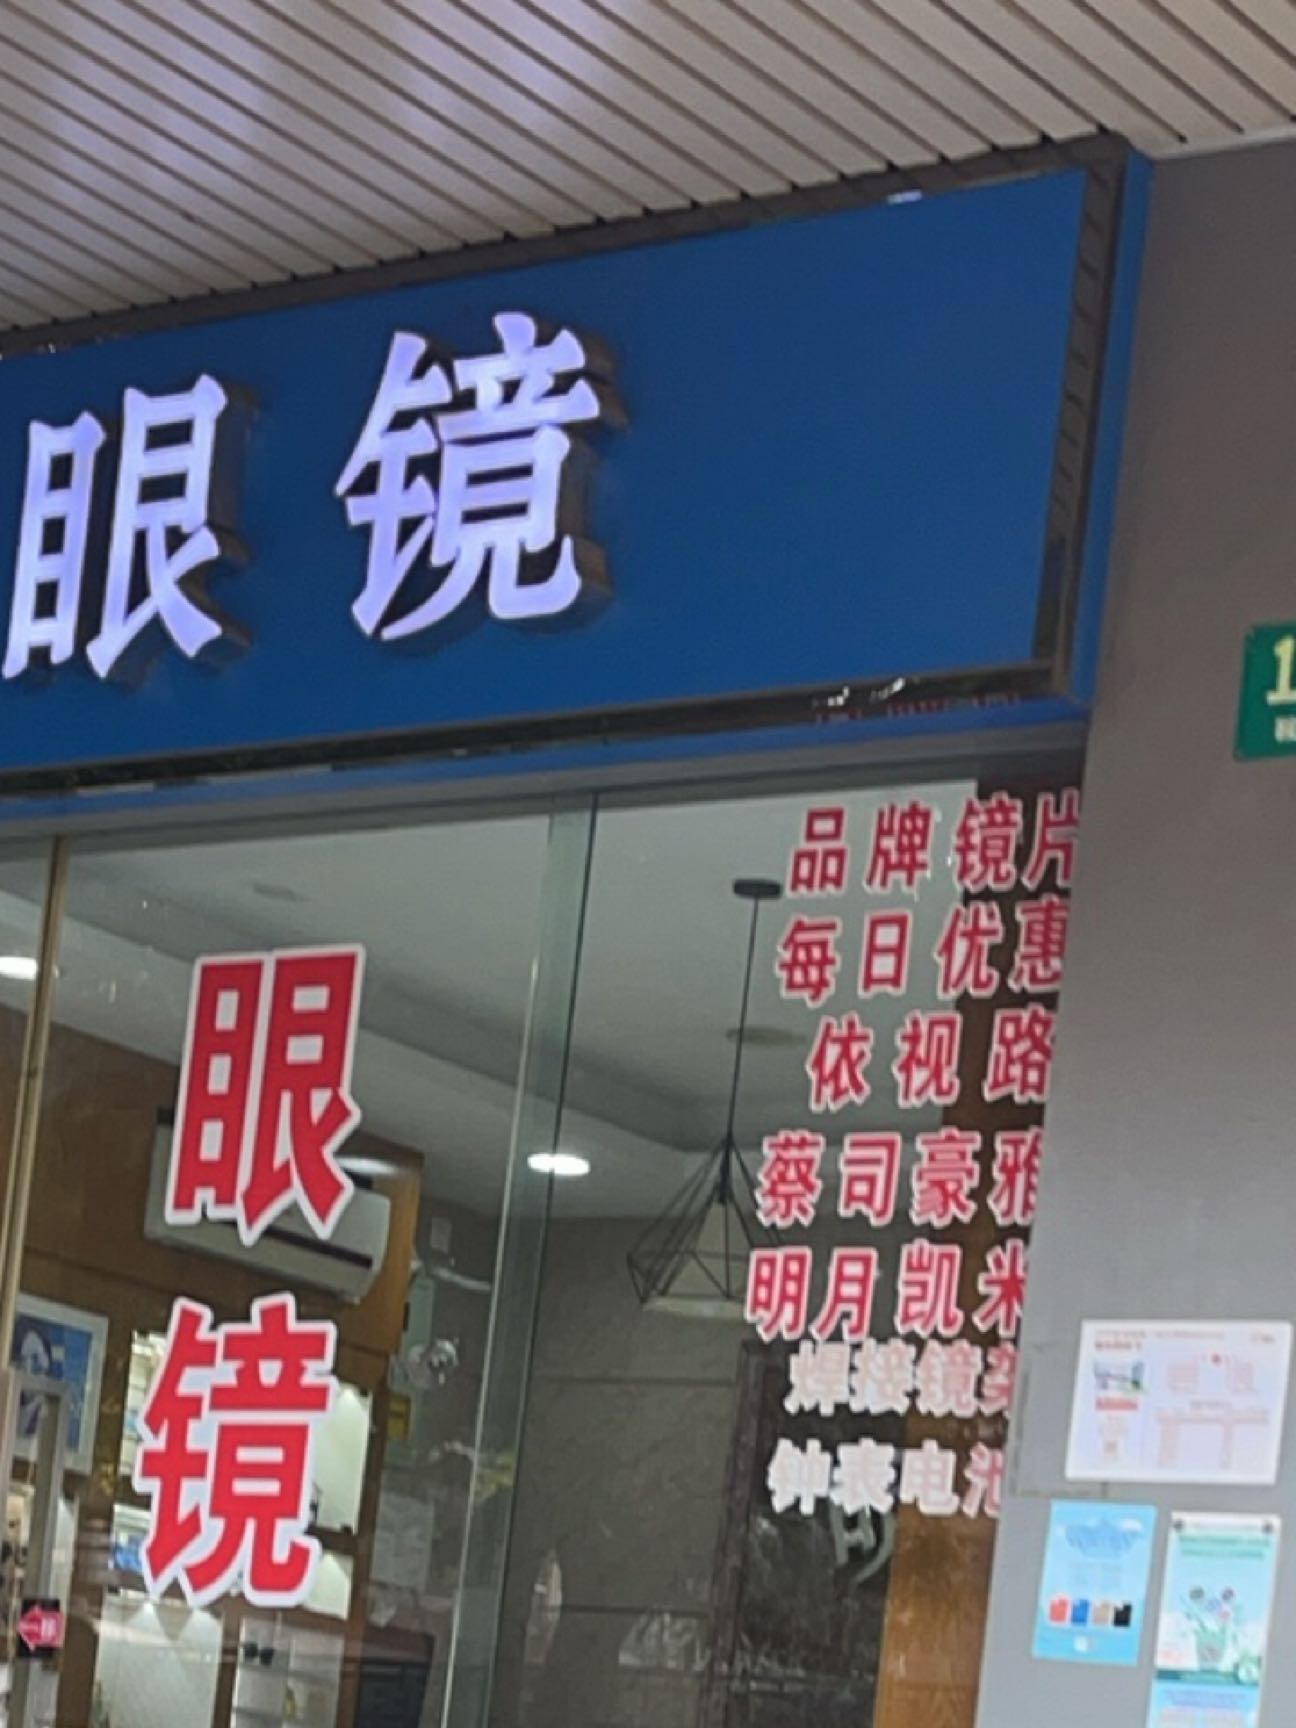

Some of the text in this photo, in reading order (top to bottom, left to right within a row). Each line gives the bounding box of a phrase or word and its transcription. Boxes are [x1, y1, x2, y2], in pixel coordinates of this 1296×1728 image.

[789, 788, 1081, 895] 品牌镜片
[776, 893, 1070, 1006] 每日优惠
[805, 1001, 1057, 1112] 依视路
[756, 1125, 1043, 1228] 蔡司豪雅
[135, 945, 365, 1609] 眼镜
[745, 1238, 1029, 1343] 明月凯米
